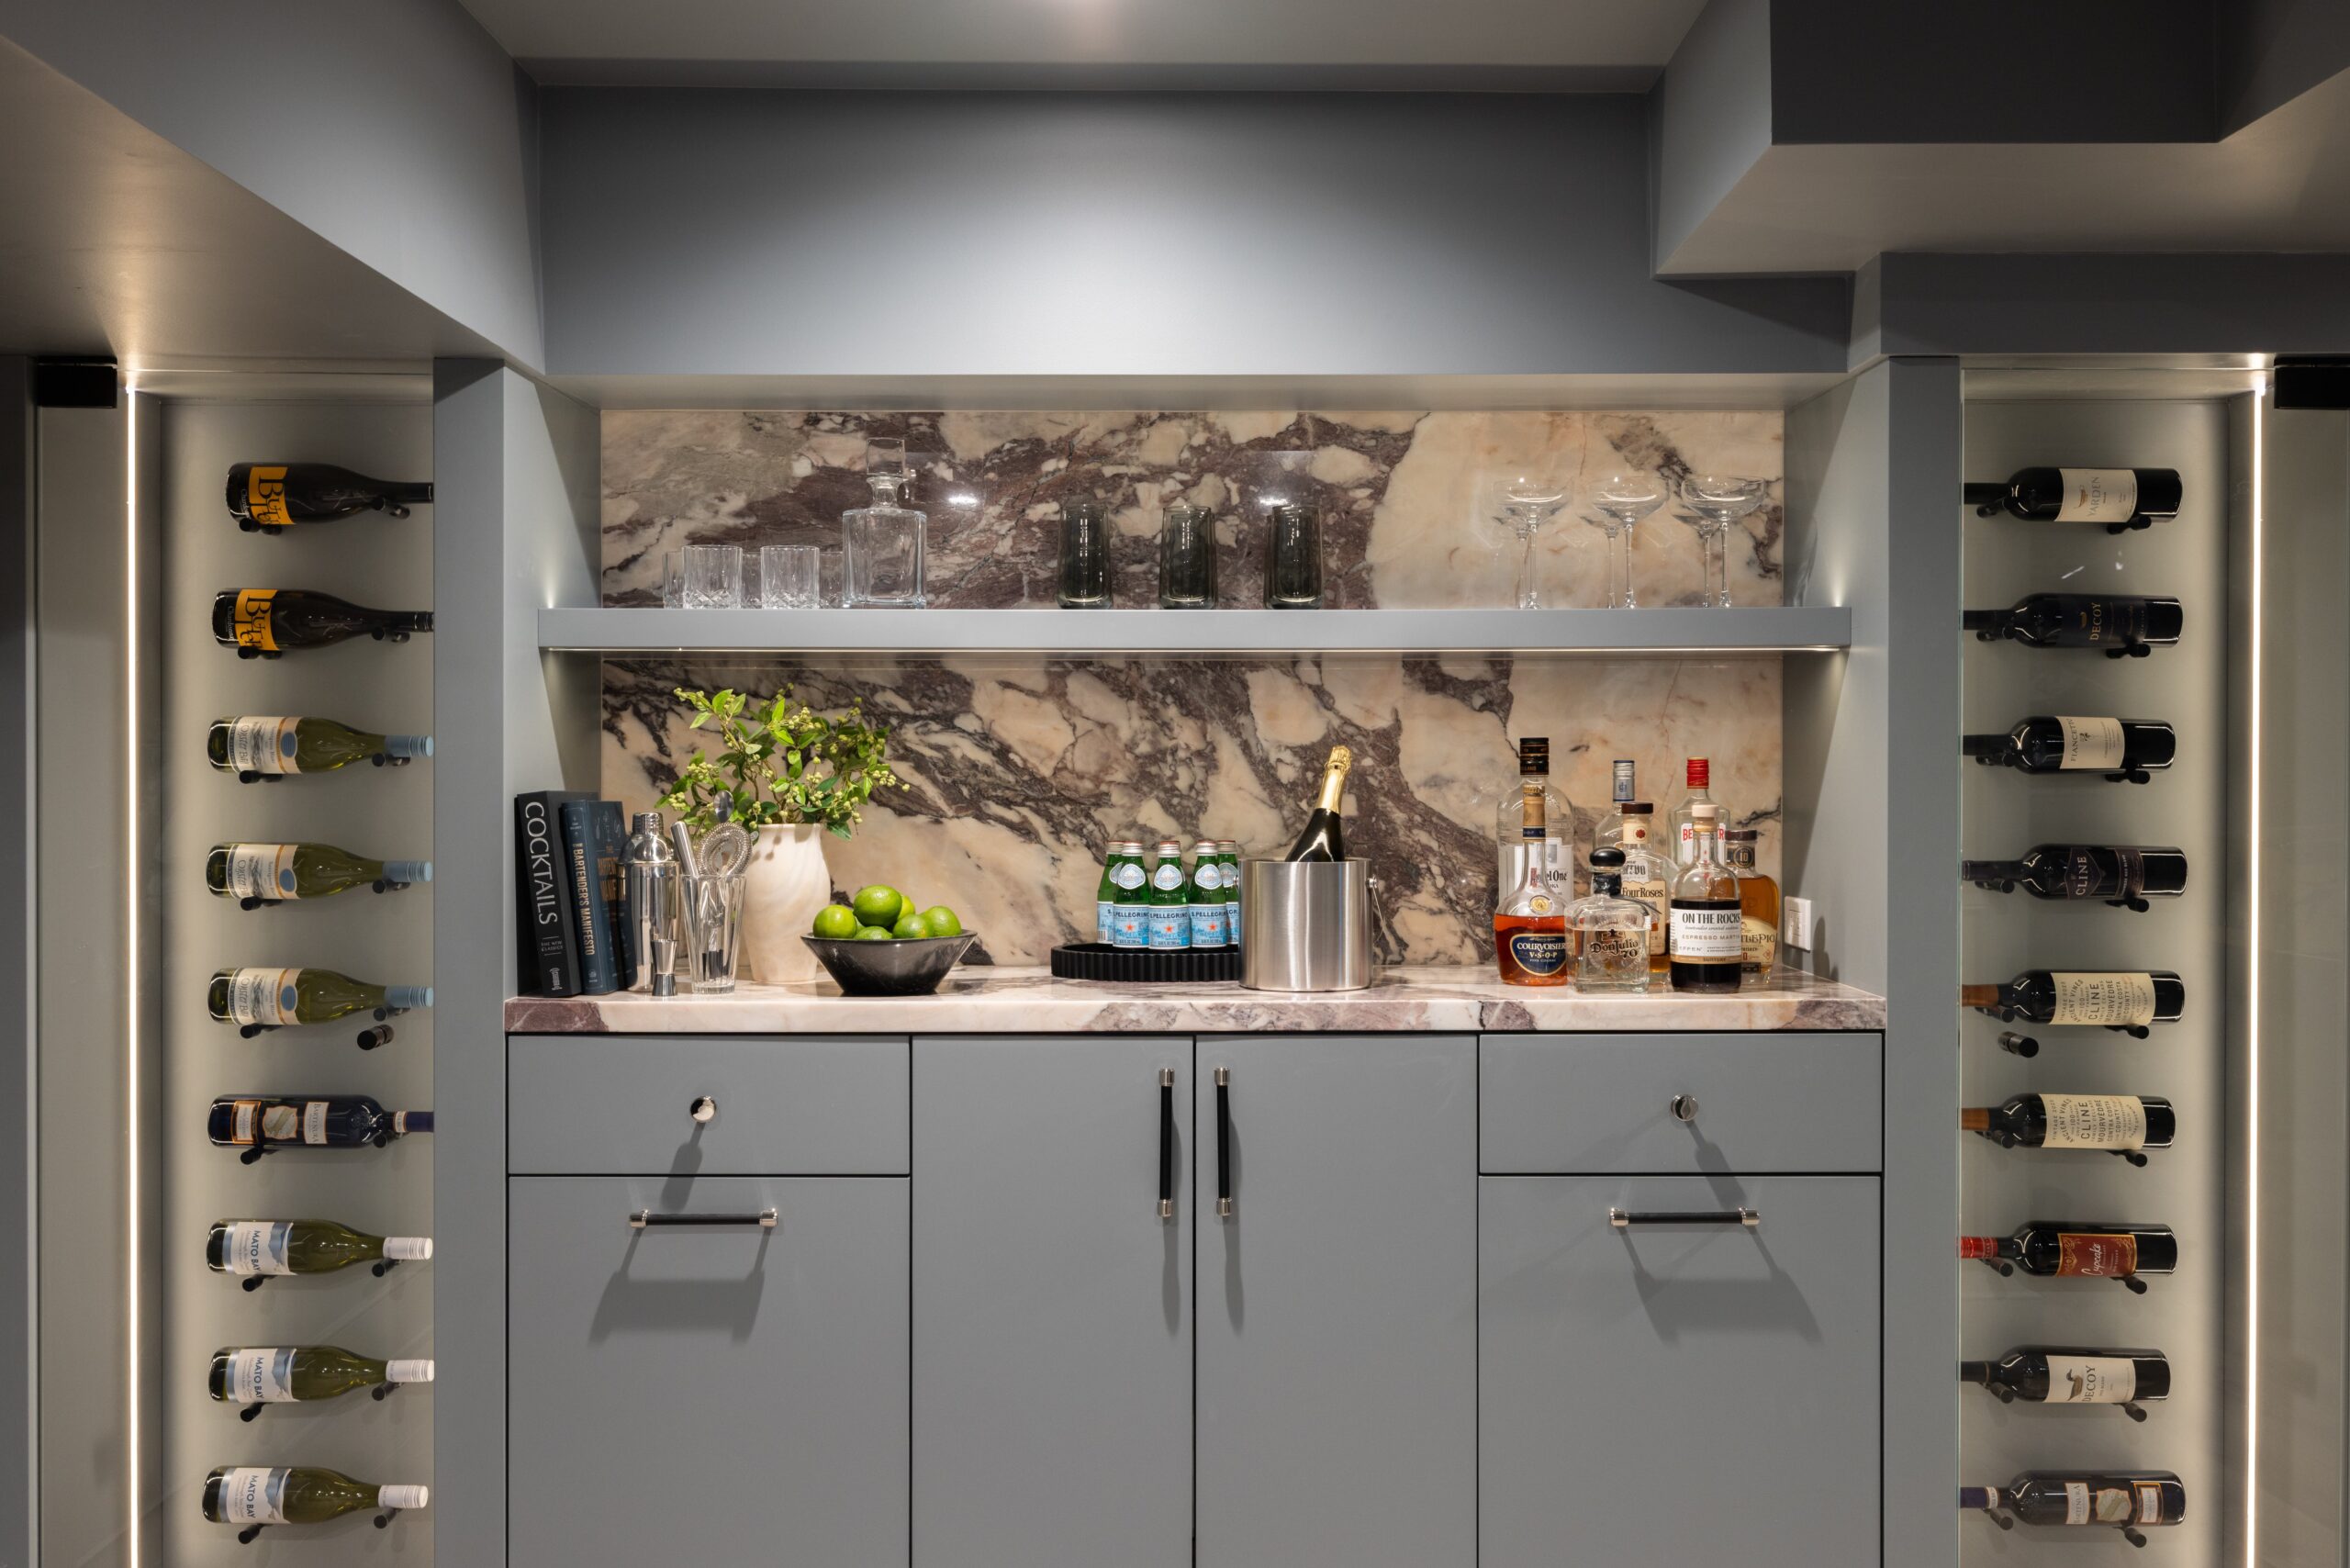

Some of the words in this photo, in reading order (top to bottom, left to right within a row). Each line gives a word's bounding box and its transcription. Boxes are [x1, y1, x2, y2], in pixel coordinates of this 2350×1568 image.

[2086, 477, 2101, 517] YARDEN
[2089, 602, 2102, 640] DECOY
[524, 801, 558, 925] COCKTAILS
[1552, 870, 1568, 881] One
[573, 848, 588, 906] BARTENDER'S
[2075, 857, 2088, 896] CLINE
[1622, 887, 1640, 898] Four
[1639, 887, 1664, 898] Roses
[580, 907, 596, 956] MANIFESTO
[1682, 913, 1695, 924] ON
[1695, 913, 1716, 924] THE
[1717, 913, 1740, 924] ROCKS
[1516, 942, 1566, 952] COURVOISIER
[1621, 948, 1639, 958] 70
[2069, 979, 2084, 997] VINES
[2115, 980, 2123, 1000] COSTA
[2068, 998, 2082, 1023] ANCIENT
[2087, 983, 2100, 1020] CLINE
[2122, 991, 2131, 1014] COUNTY
[2078, 1102, 2091, 1139] CLINE
[2104, 1100, 2113, 1117] COSTA
[2059, 1116, 2074, 1143] ANCIENT
[250, 1230, 263, 1257] MATO
[251, 1259, 263, 1271] BAY
[2080, 1243, 2105, 1276] Cupcake
[253, 1357, 265, 1383] MATO
[2081, 1364, 2097, 1402] DECOY
[254, 1385, 265, 1399] BAY
[246, 1474, 260, 1502] MATO
[246, 1504, 256, 1518] BAY
